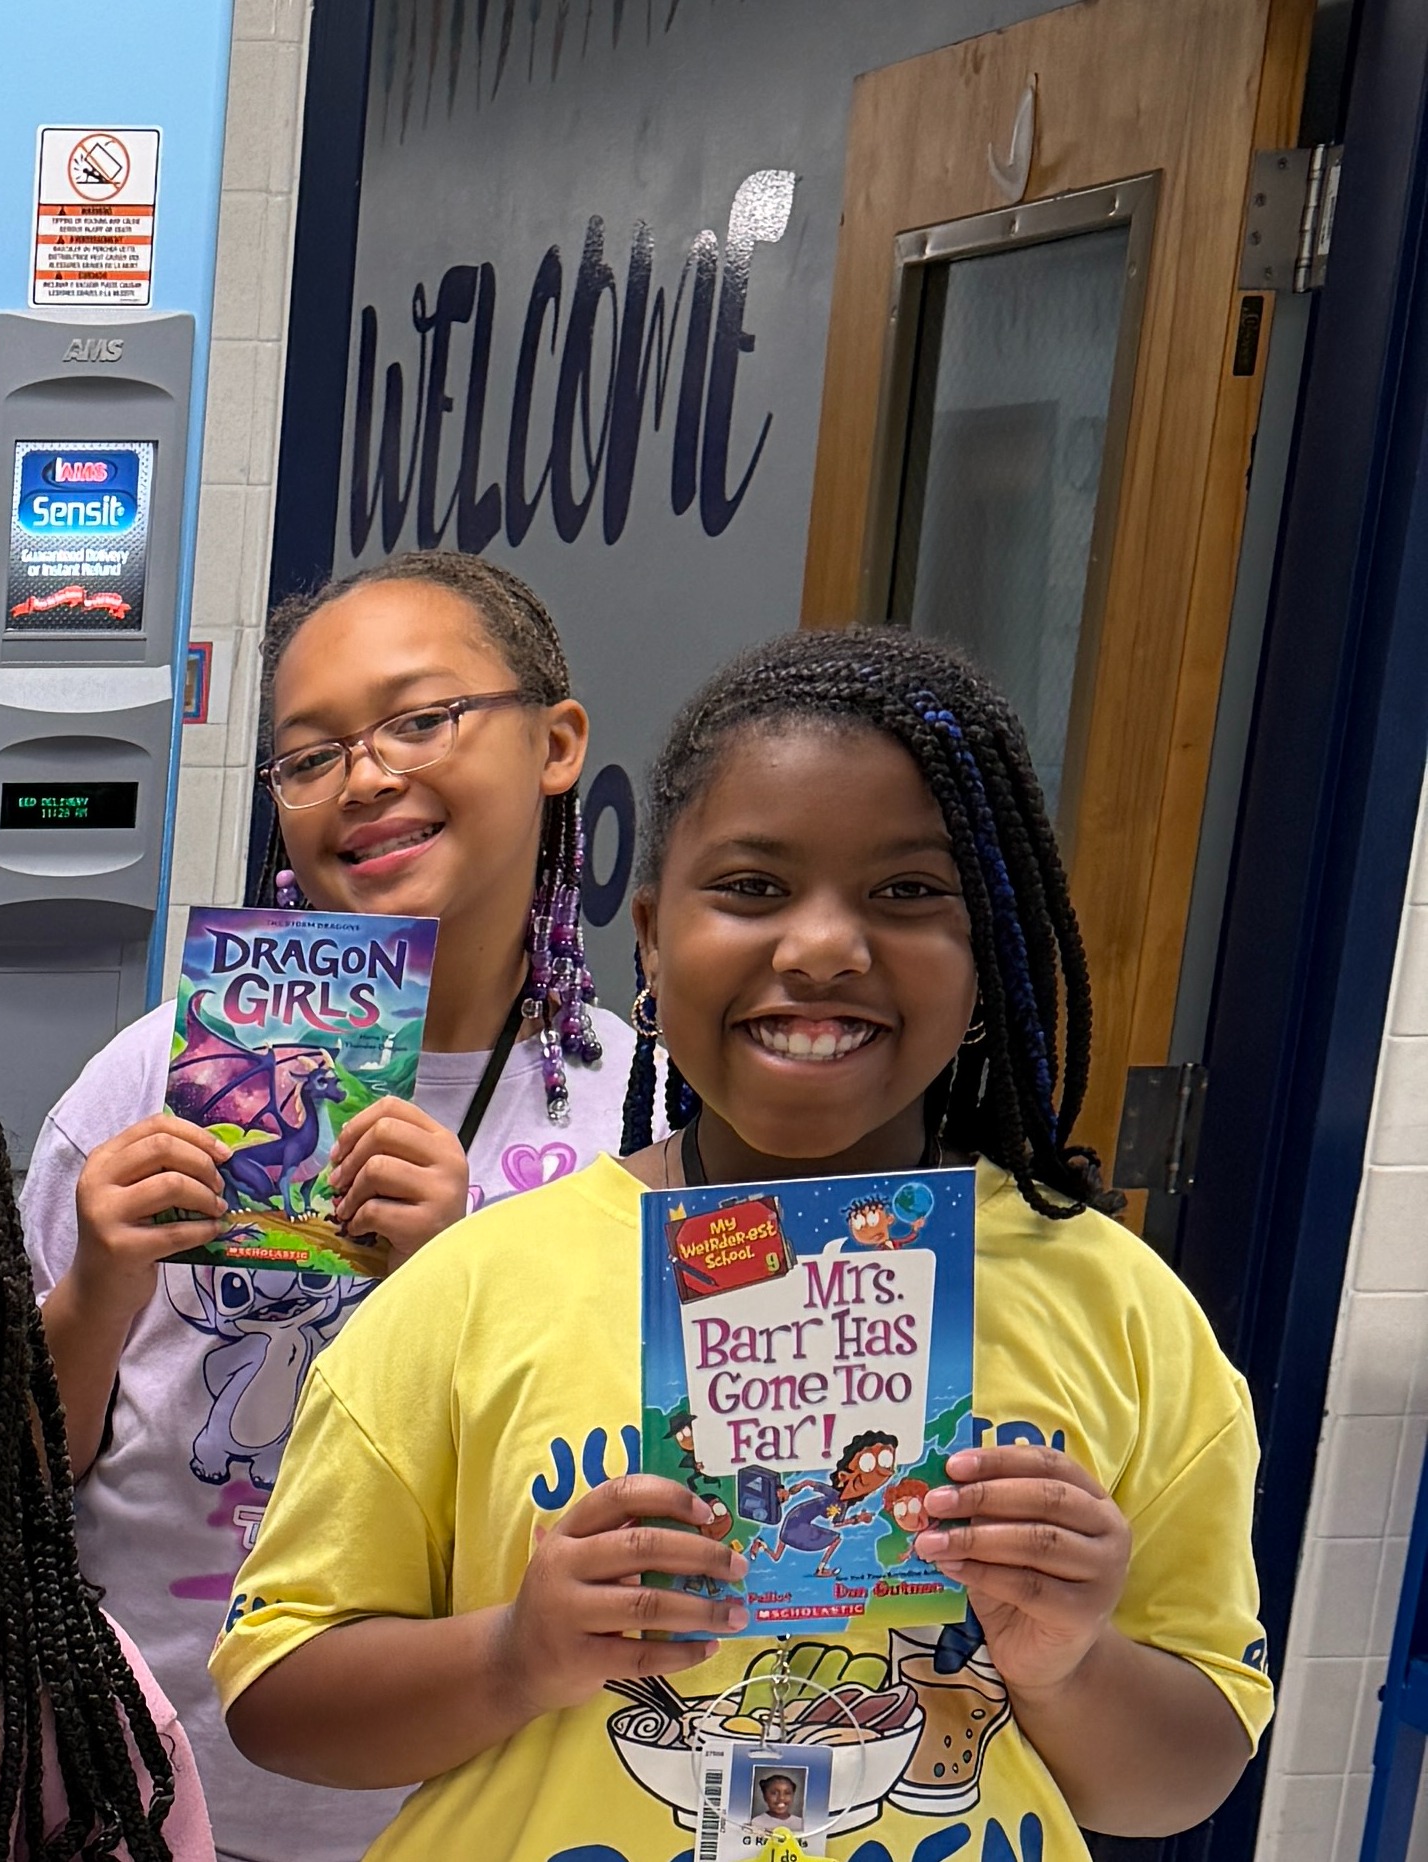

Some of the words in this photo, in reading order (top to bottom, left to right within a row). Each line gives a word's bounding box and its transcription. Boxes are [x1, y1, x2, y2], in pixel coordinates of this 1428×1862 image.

[62, 339, 124, 363] AMS
[350, 169, 797, 558] WELCOME
[204, 928, 406, 989] DRAGON
[223, 972, 381, 1034] GIRLS
[710, 1216, 737, 1235] My
[238, 1247, 309, 1260] SCHOLASTIC
[766, 1252, 780, 1272] 9
[801, 1259, 904, 1310] Mrs.
[691, 1316, 824, 1372] Barr
[831, 1307, 918, 1363] Has
[707, 1370, 829, 1415] Gone
[833, 1363, 913, 1407] Too
[726, 1413, 837, 1465] Far!
[770, 1604, 863, 1618] SCHOLASTIC
[833, 1582, 869, 1600] Dan
